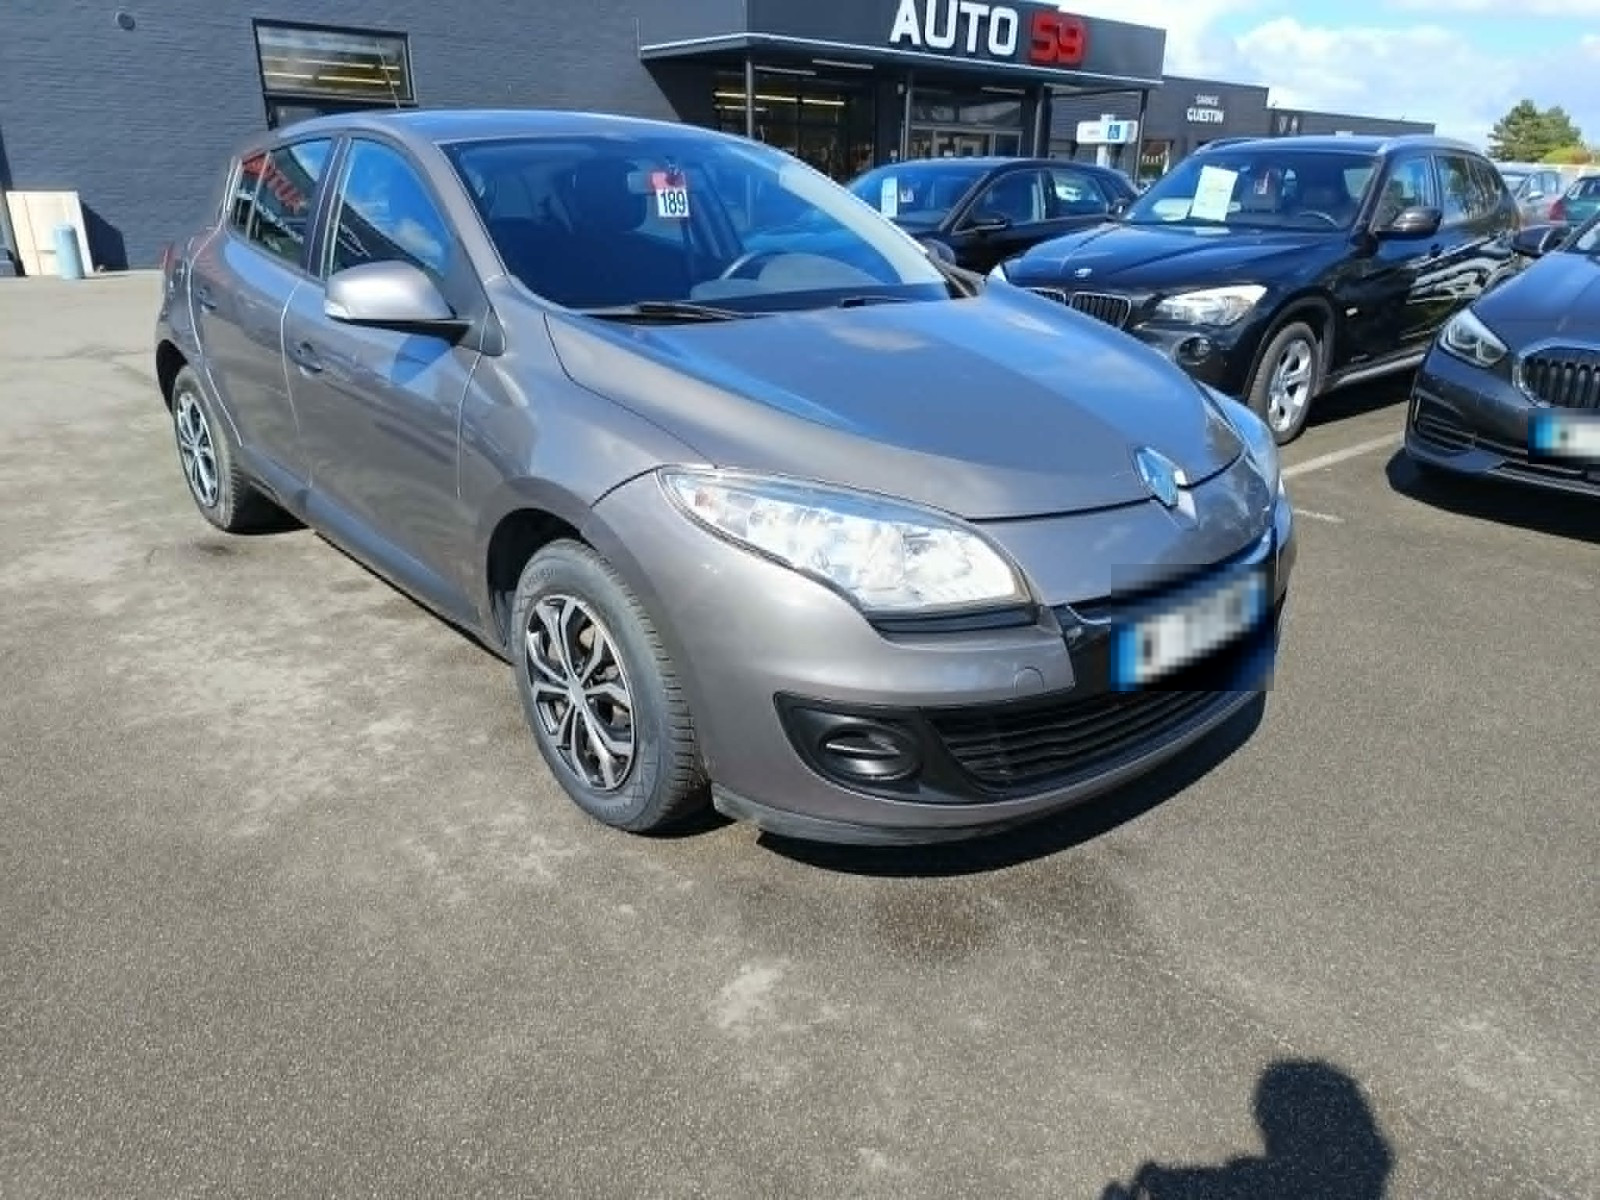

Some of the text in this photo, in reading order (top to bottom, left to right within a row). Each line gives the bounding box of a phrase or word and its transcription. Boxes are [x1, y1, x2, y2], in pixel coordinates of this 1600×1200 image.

[889, 0, 1085, 64] AUTO 59
[660, 191, 686, 214] 189
